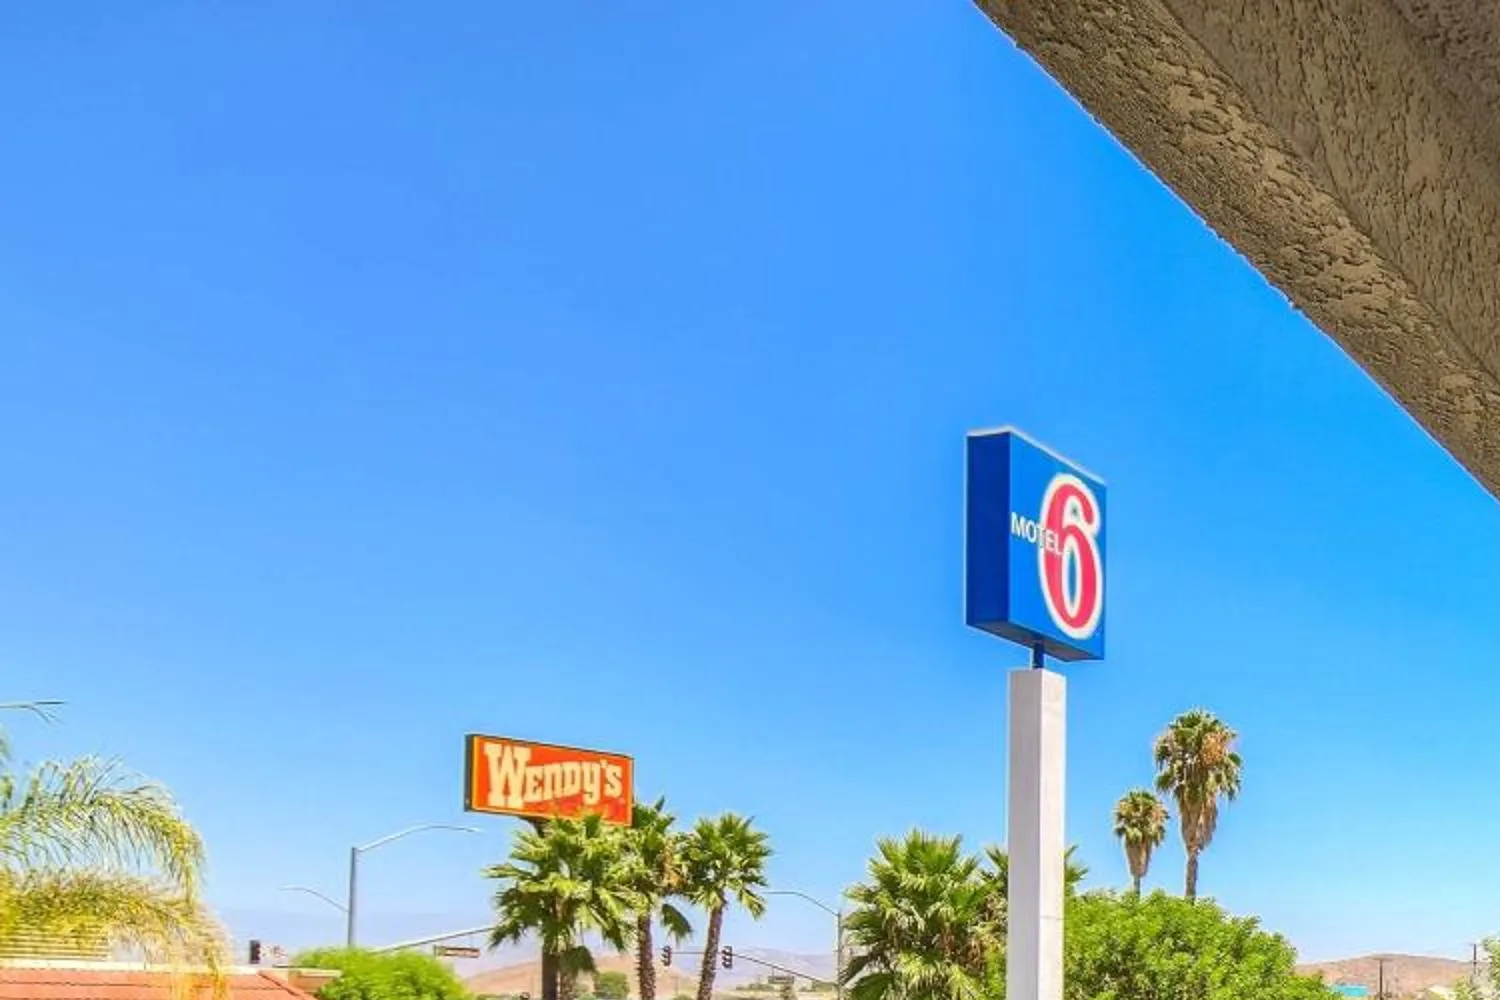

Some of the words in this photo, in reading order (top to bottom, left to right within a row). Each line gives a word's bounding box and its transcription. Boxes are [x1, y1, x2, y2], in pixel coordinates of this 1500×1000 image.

[1010, 511, 1066, 557] MOTEL
[1040, 474, 1103, 639] 6
[484, 741, 623, 809] Wendy's
